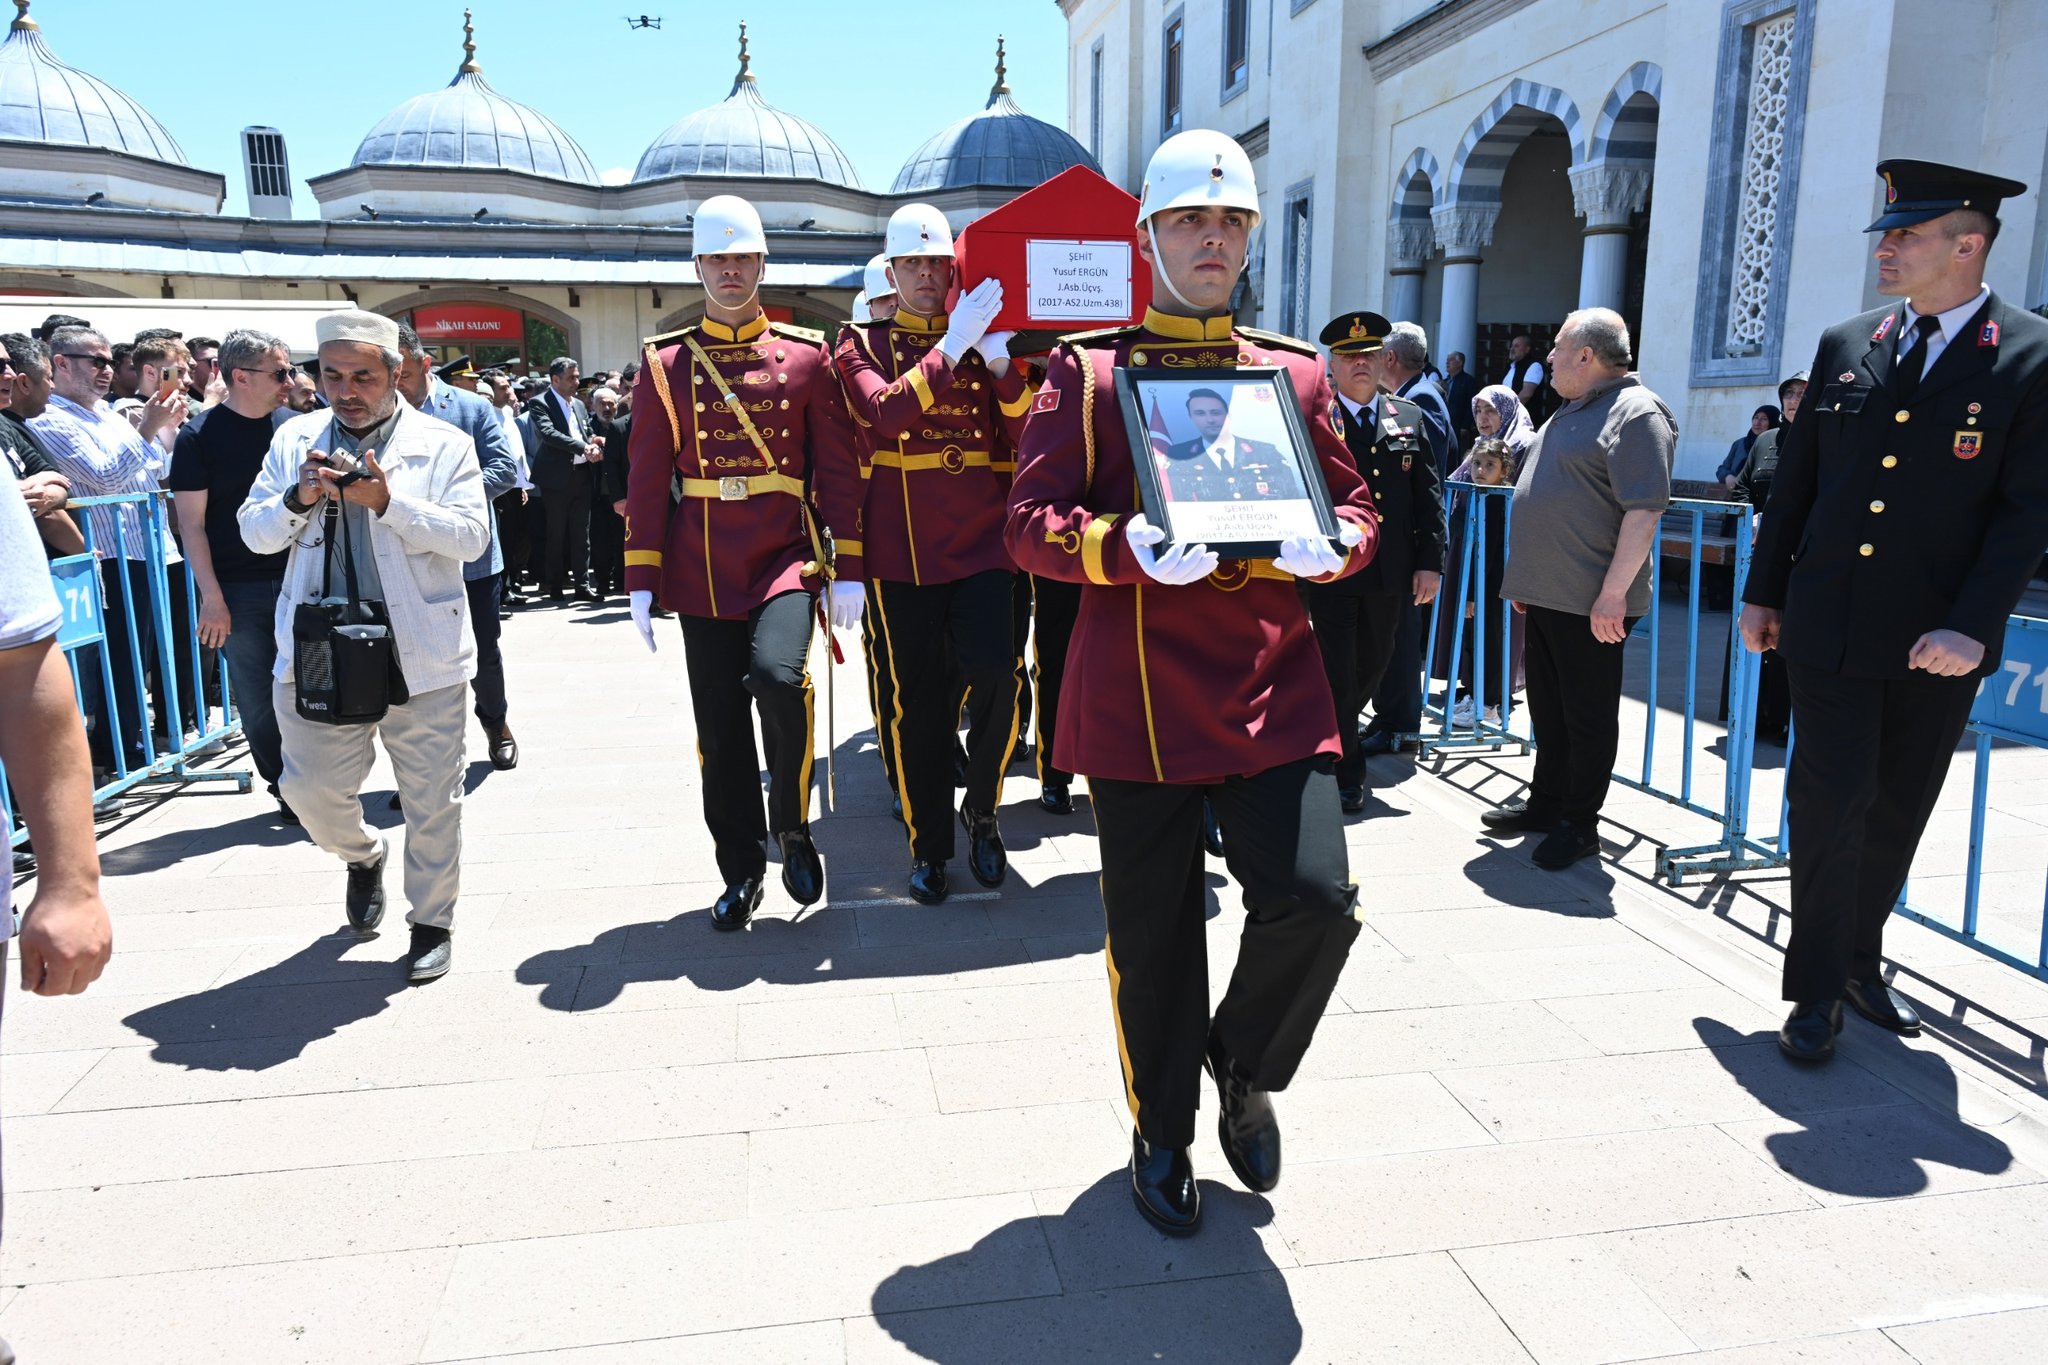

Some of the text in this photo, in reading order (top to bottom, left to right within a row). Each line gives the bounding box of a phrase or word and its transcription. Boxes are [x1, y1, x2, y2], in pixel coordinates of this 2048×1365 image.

[1069, 251, 1093, 262] ŞEHİT
[1053, 267, 1108, 277] Yusuf ERGÜN
[1038, 297, 1123, 308] (2017-AS2.Uzm.438)
[436, 320, 501, 330] NİKAH SALONU
[65, 585, 92, 623] 71
